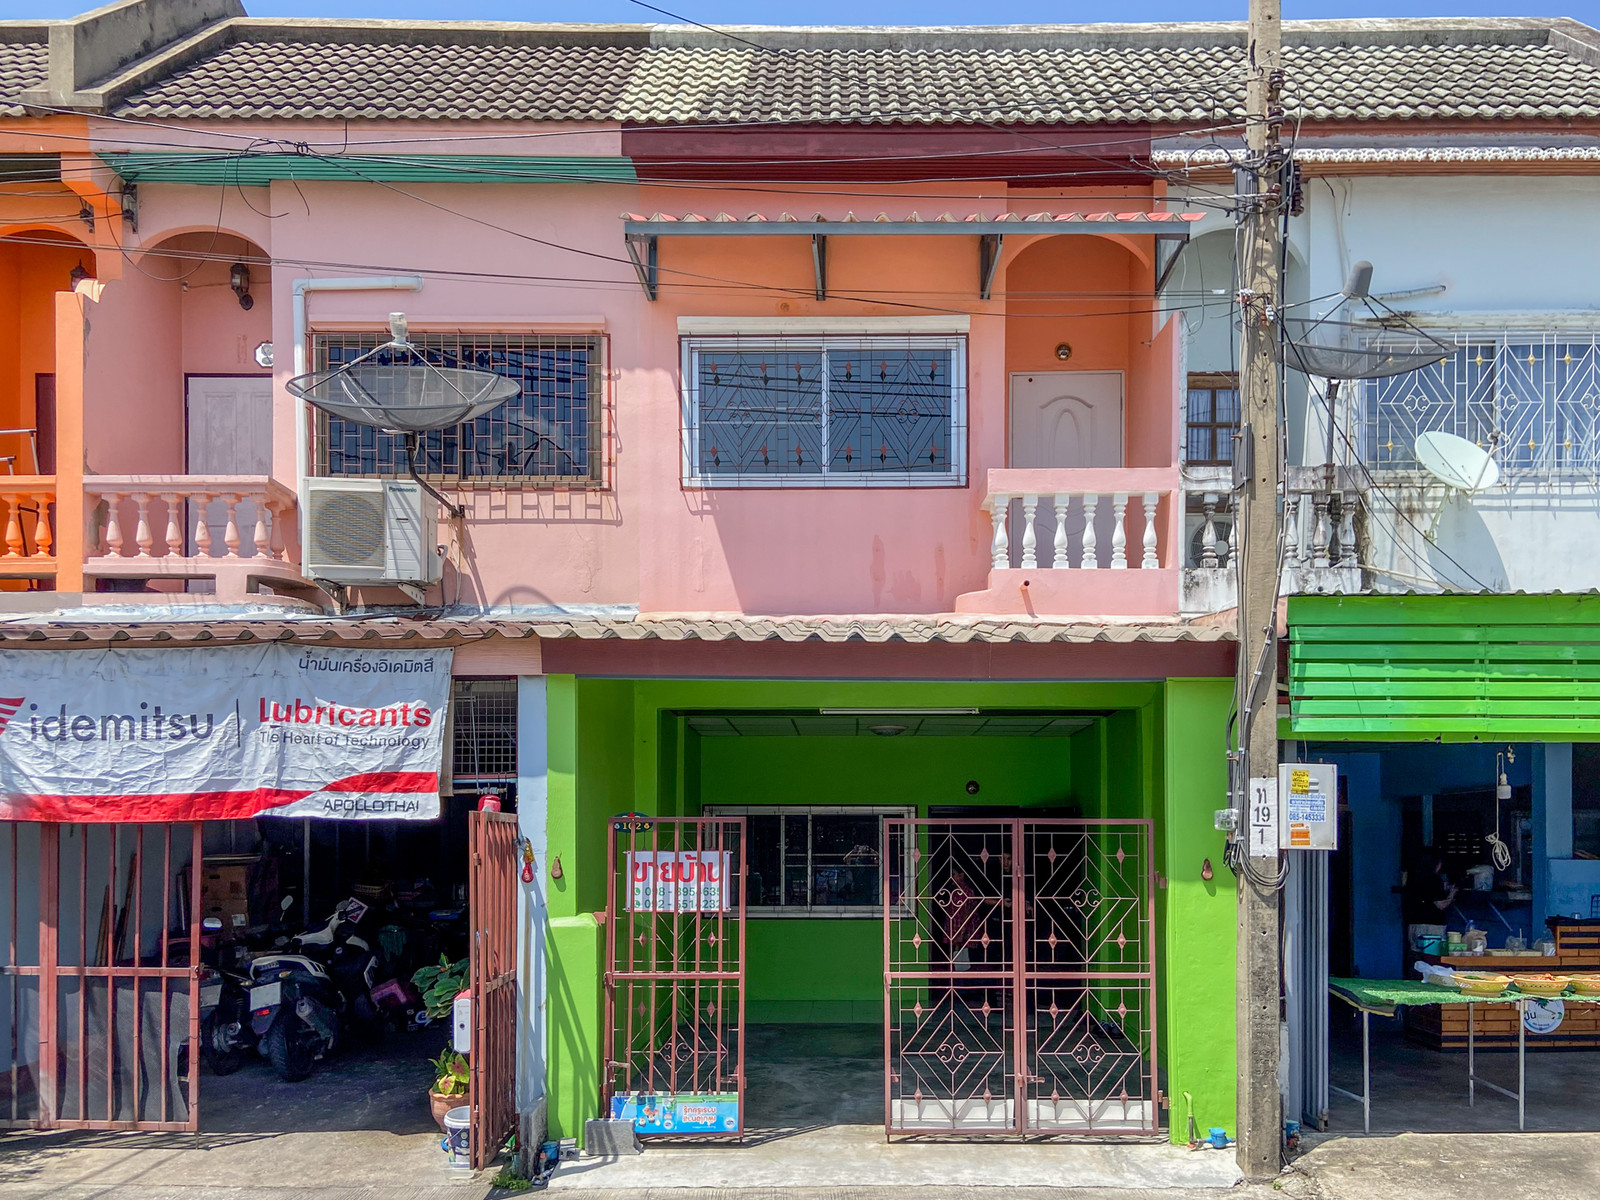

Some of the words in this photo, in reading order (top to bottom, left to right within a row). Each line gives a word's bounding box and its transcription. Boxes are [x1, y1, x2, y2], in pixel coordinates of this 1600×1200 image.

[259, 697, 432, 727] Lubricants
[29, 701, 214, 742] idemitsu
[283, 731, 320, 744] Heart
[324, 734, 340, 745] of
[323, 798, 419, 812] APOLLOTHAI
[1254, 806, 1271, 822] 19
